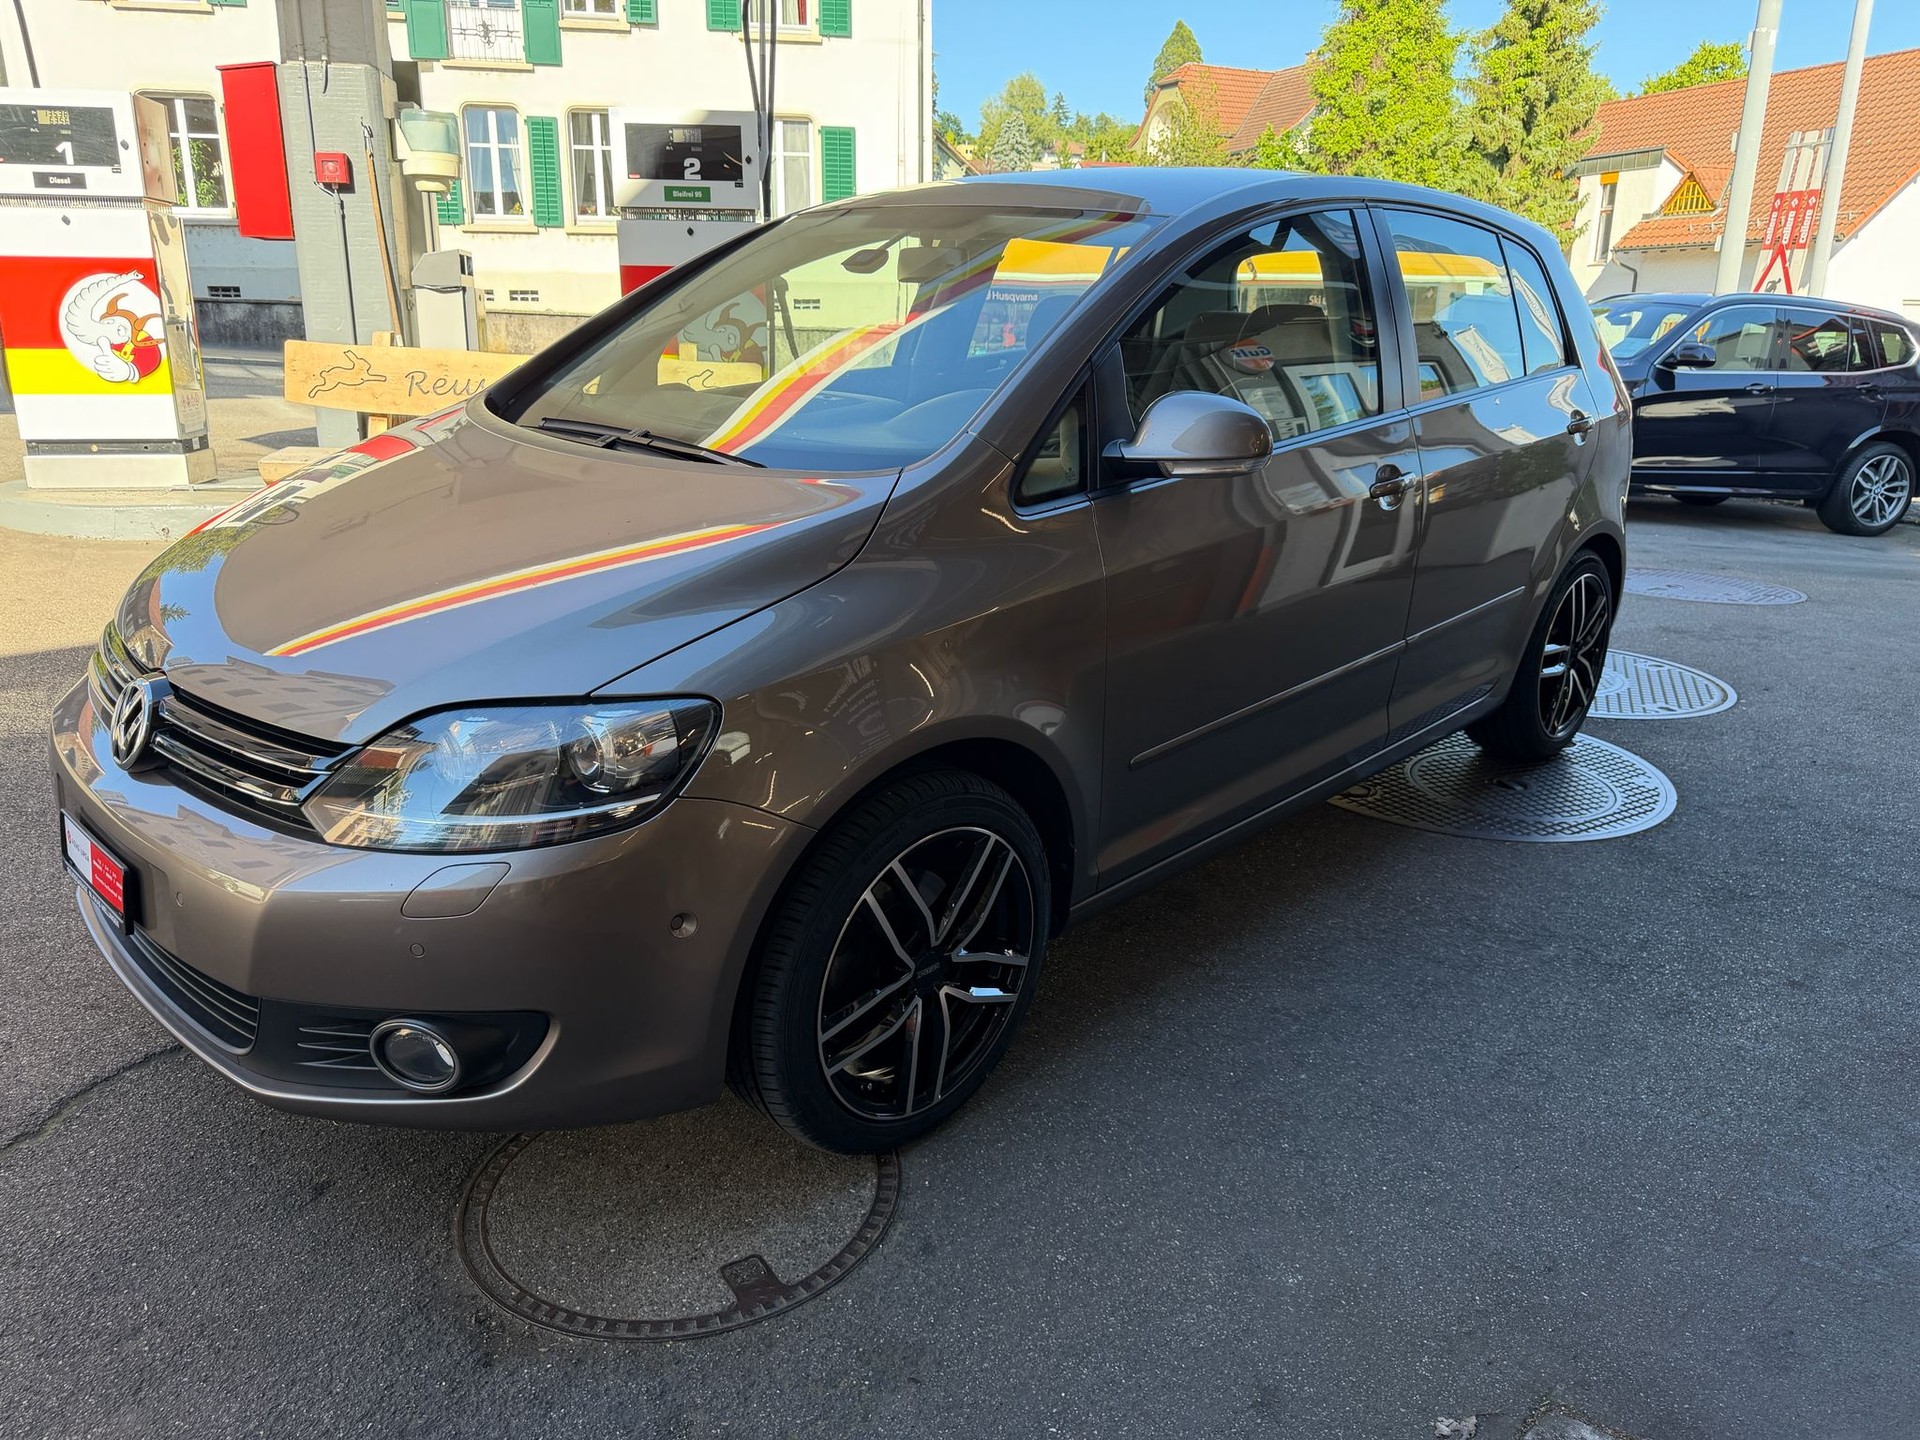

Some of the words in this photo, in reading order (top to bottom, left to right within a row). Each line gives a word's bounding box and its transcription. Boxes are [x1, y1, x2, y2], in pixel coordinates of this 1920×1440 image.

[55, 141, 75, 165] 1
[683, 157, 701, 180] 2
[49, 176, 71, 184] Diesel
[992, 290, 1038, 303] Husqvarna
[1308, 294, 1322, 306] Ski
